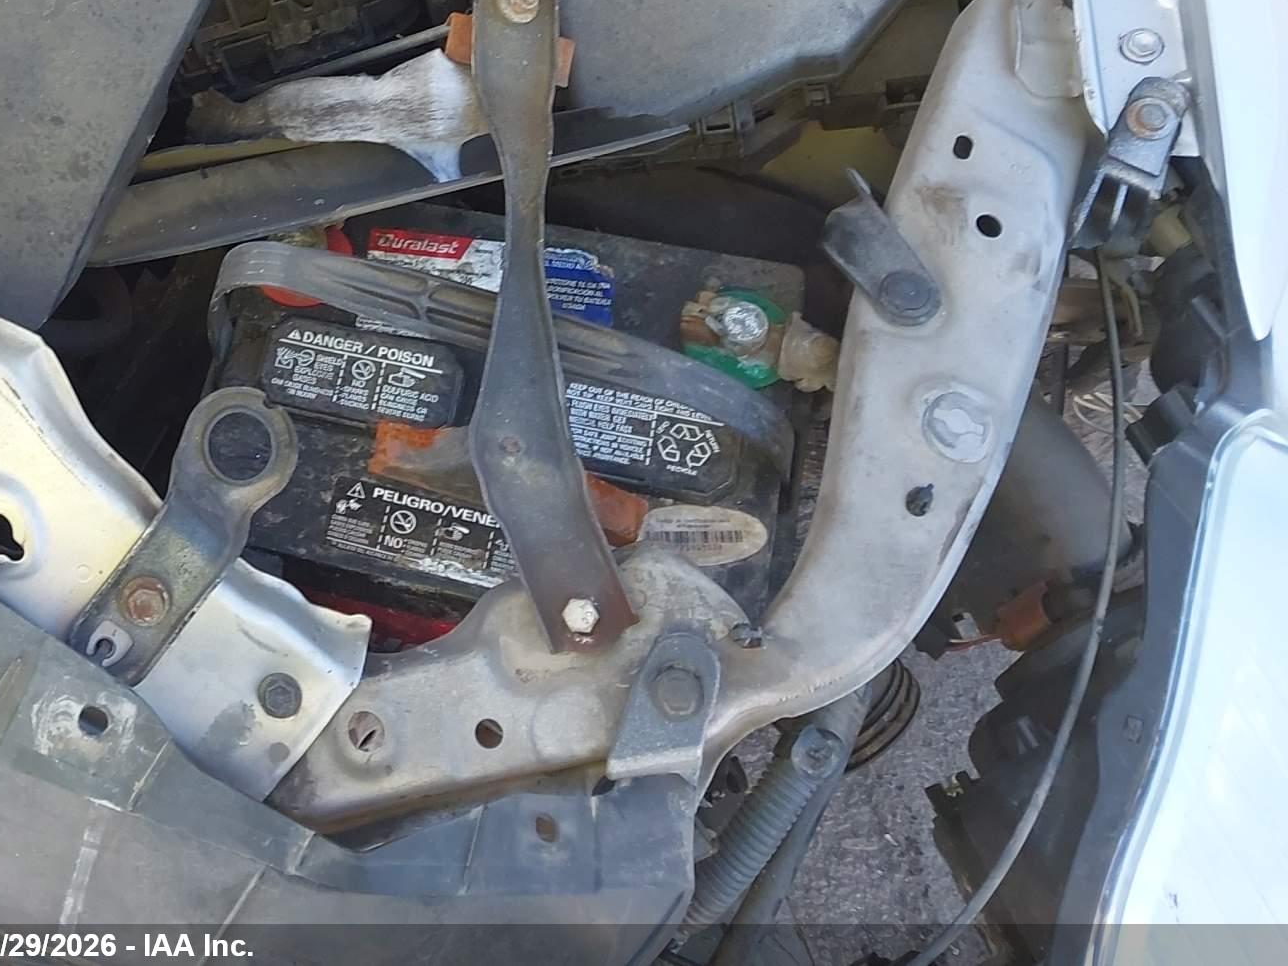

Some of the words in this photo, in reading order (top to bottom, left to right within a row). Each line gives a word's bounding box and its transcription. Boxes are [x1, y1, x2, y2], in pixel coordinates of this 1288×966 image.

[377, 232, 460, 255] Duralast
[302, 331, 364, 355] DANGER
[365, 345, 377, 355] /
[377, 346, 434, 368] POISON
[351, 379, 366, 388] NO
[373, 487, 501, 529] PELIGRO/VENE
